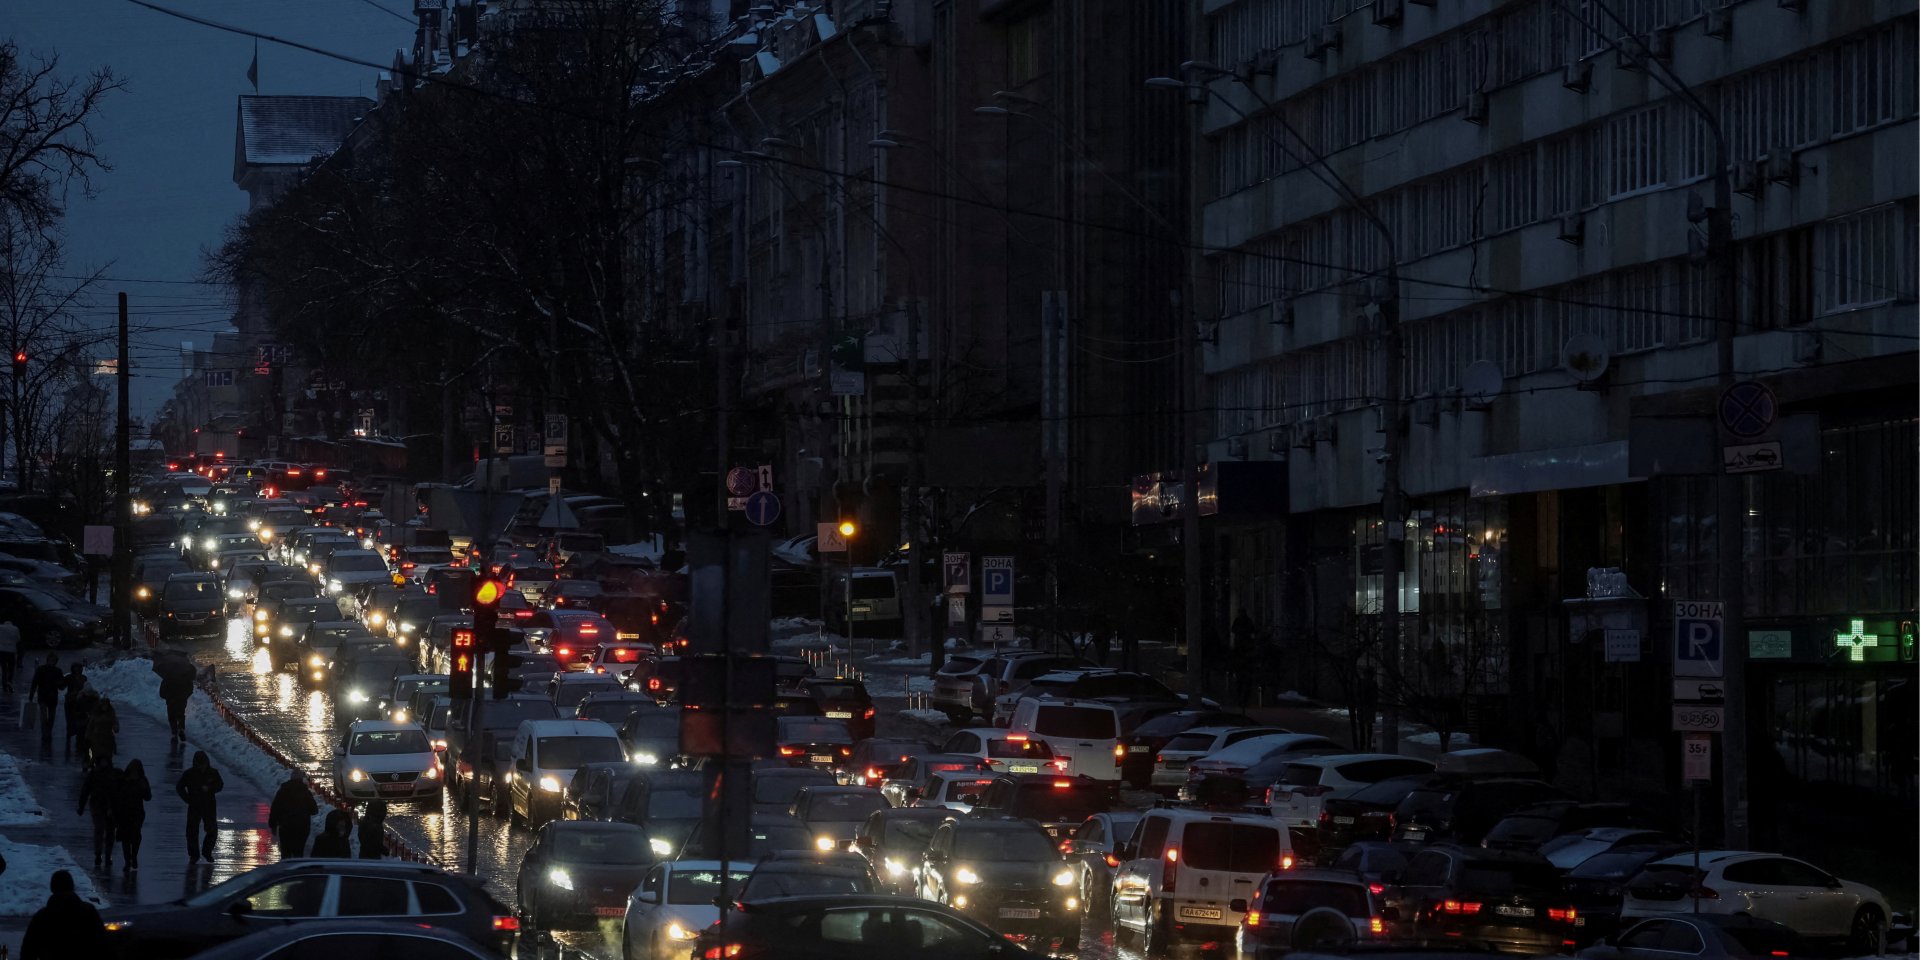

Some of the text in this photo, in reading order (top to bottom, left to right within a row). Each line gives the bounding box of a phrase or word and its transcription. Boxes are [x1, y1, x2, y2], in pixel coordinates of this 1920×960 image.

[984, 559, 1013, 569] ЗОНА
[991, 572, 1004, 592] P
[1677, 603, 1723, 619] ЗОНА
[455, 633, 471, 646] 23
